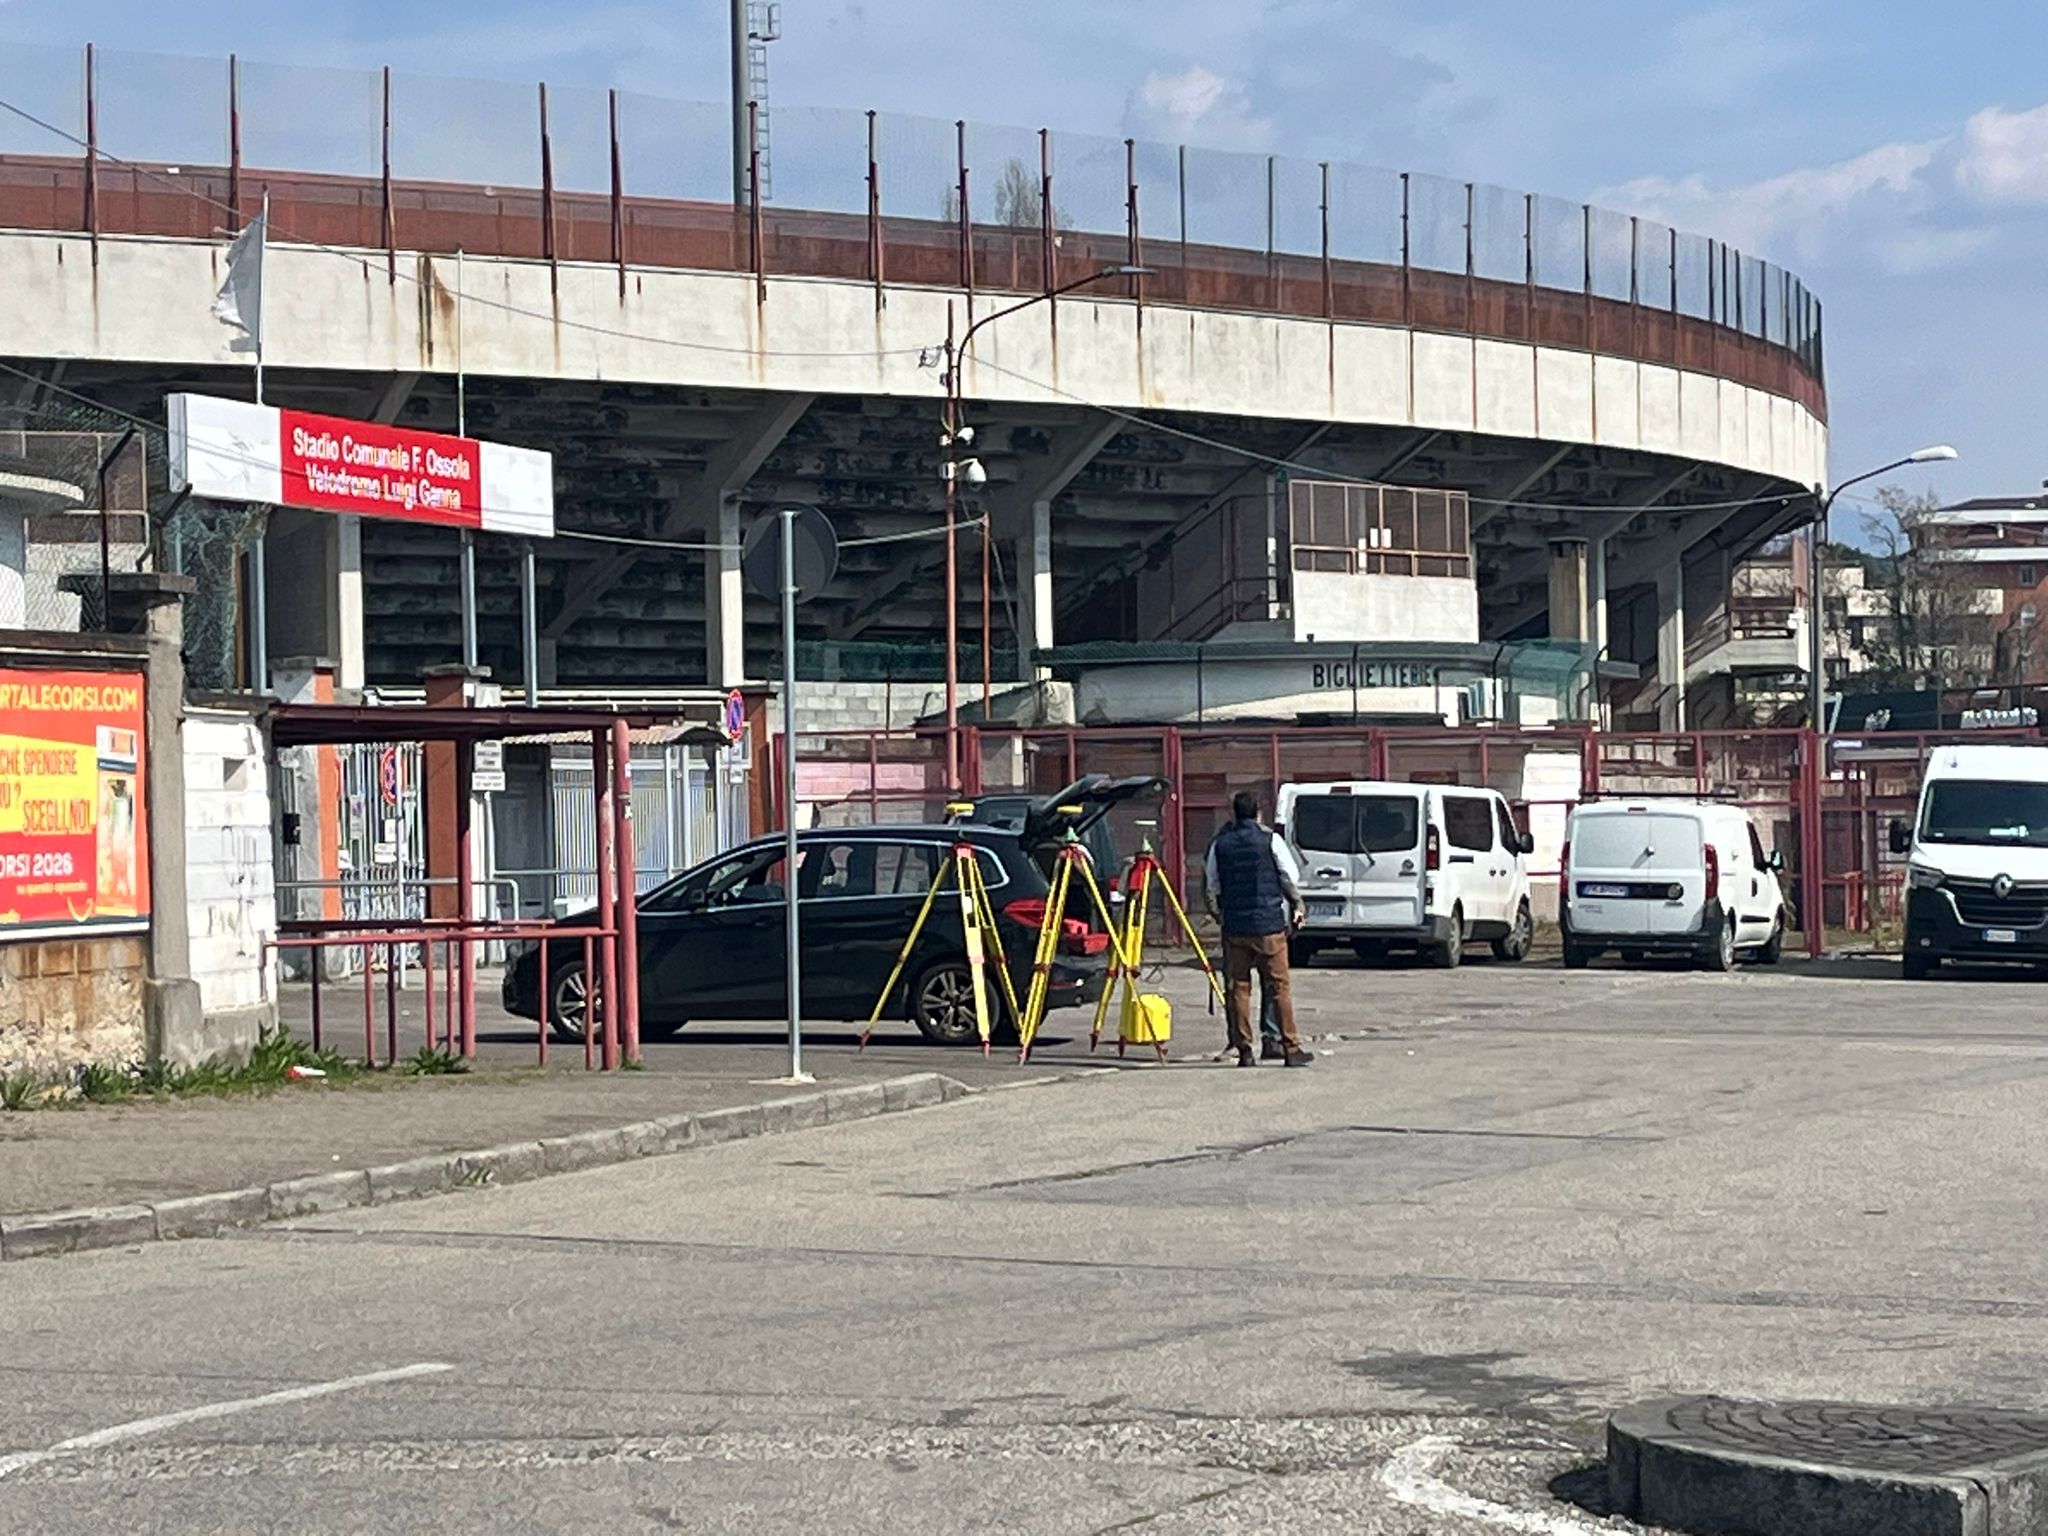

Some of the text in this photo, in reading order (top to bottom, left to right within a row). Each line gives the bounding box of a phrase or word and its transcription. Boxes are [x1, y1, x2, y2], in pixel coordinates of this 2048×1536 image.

[293, 427, 471, 480] Stadio Comunale F. Ossola
[304, 462, 462, 510] Velodromo Luigi Ganna
[1312, 663, 1432, 688] BIGLIETTERIE
[23, 749, 78, 776] SPENDERE
[32, 852, 73, 877] 2026
